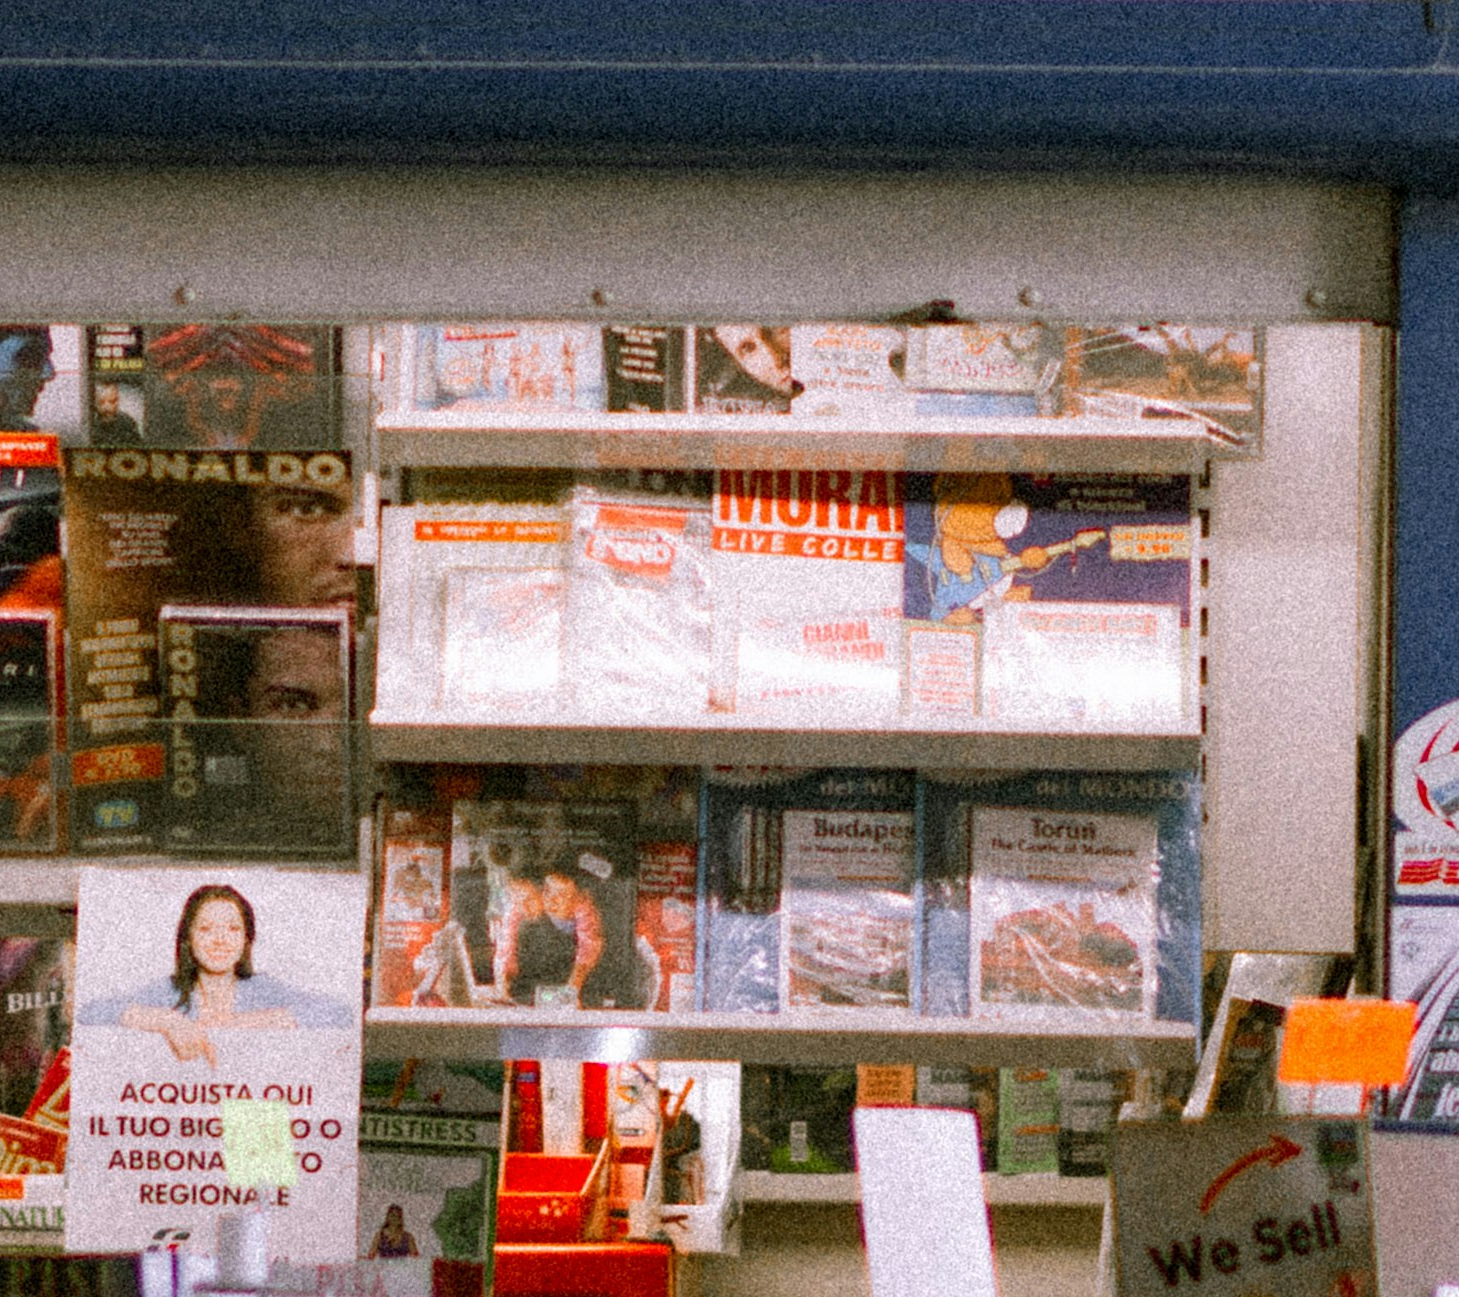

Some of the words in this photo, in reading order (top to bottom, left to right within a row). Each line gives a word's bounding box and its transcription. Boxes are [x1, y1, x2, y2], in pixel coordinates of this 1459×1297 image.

[72, 449, 348, 485] RONALDO
[720, 530, 786, 555] LIVE
[120, 1082, 253, 1105] ACQUISTA
[262, 1083, 314, 1106] QUI
[89, 1116, 110, 1136] IL
[116, 1116, 171, 1137] TUO
[361, 1116, 478, 1144] NTISTRESS
[108, 1150, 323, 1174] ABBONAO
[139, 1183, 290, 1207] REGIONAE
[1144, 1234, 1242, 1294] We
[1250, 1198, 1344, 1270] Sell
